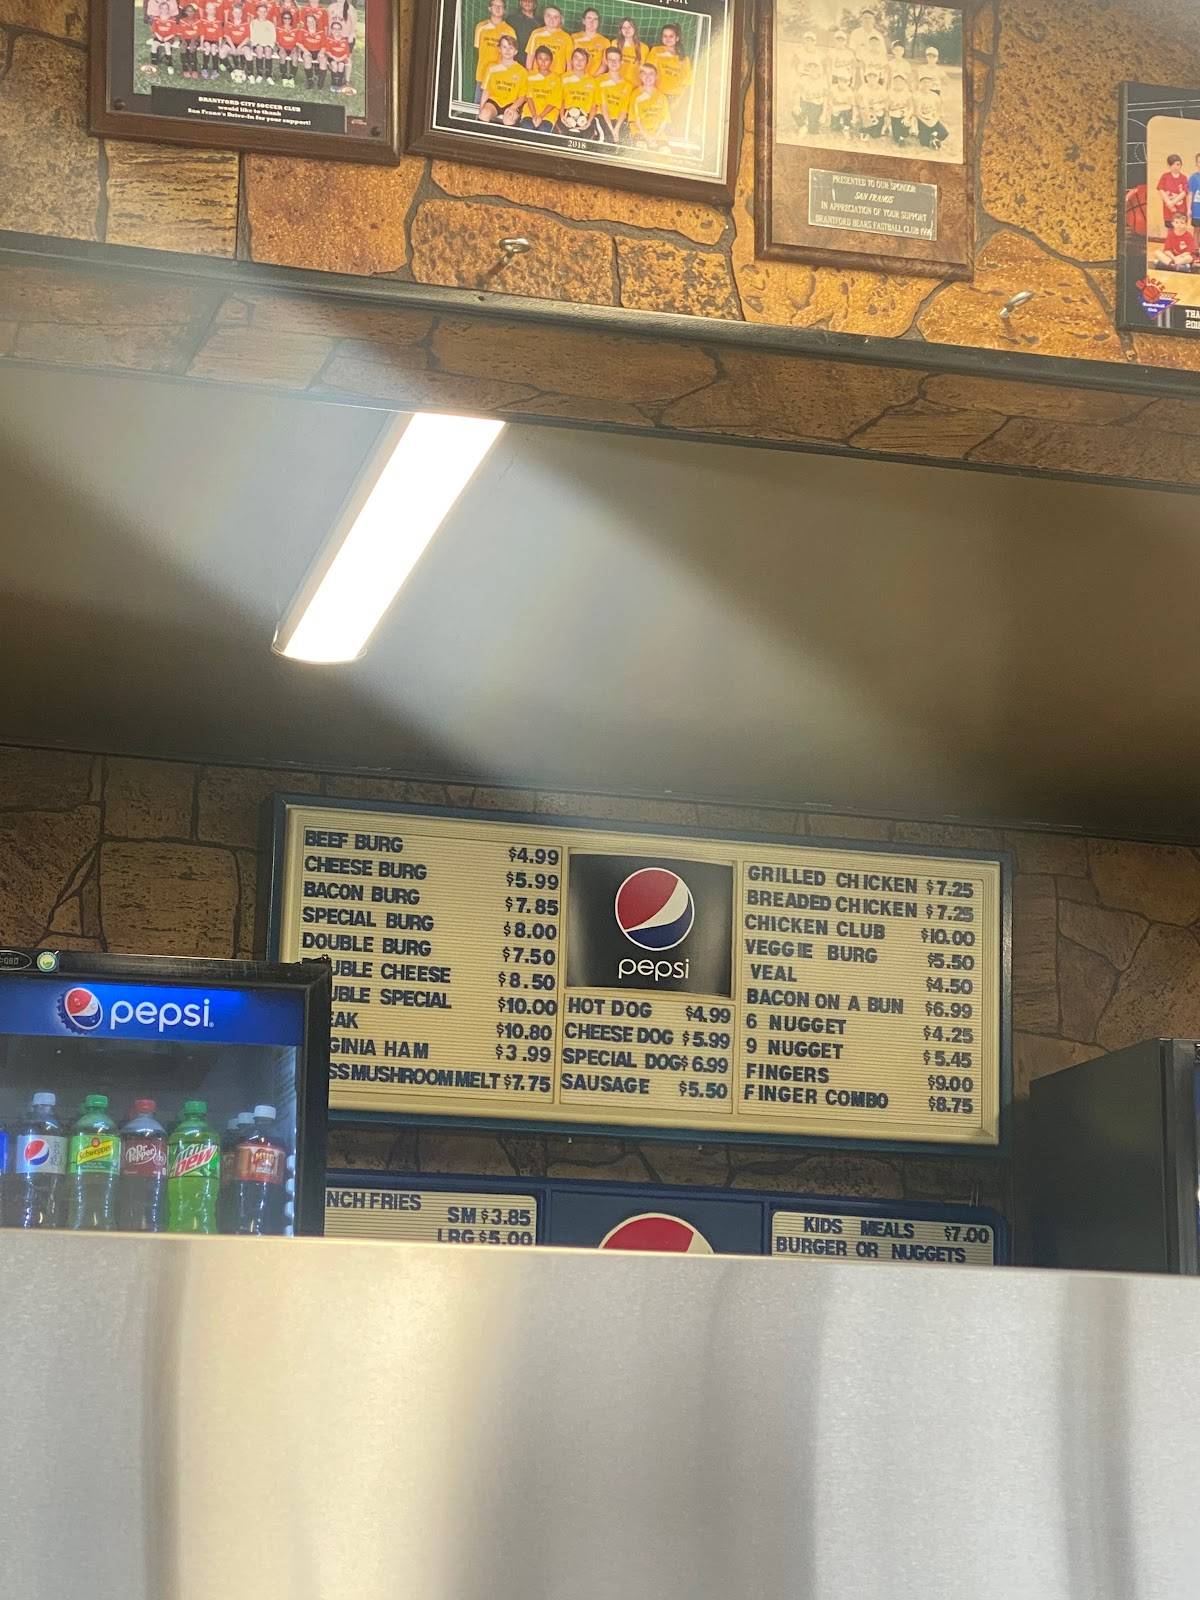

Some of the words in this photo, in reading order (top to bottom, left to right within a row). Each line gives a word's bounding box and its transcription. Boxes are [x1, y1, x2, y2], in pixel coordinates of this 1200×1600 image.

[240, 100, 256, 108] CITY
[568, 139, 586, 149] 2018
[832, 174, 867, 187] PRESENTED
[304, 829, 348, 848] BEEF
[354, 833, 404, 853] BURG
[508, 846, 559, 865] $4.99
[304, 855, 373, 876] CHEESE
[378, 861, 428, 880] BURG
[506, 871, 559, 890] $5.99
[749, 865, 826, 886] GRILLED
[835, 872, 918, 894] CHICKEN
[926, 879, 974, 898] $7.25
[303, 880, 364, 901] BACON
[371, 885, 421, 905] BURG
[505, 896, 559, 915] $7.85
[747, 889, 832, 911] BREADED
[835, 896, 918, 918] CHICKEN
[926, 903, 975, 923] $7.25
[302, 906, 377, 928] SPECIAL
[385, 912, 434, 932] BURG
[503, 921, 557, 940] $8.00
[744, 914, 829, 936] CHICKEN
[836, 921, 886, 940] CLUB
[921, 927, 976, 947] $10.00
[302, 932, 374, 953] DOUBLE
[382, 937, 432, 957] BURG
[502, 946, 556, 966] $7.50
[745, 938, 813, 959] VEGGIE
[827, 944, 878, 964] BURG
[927, 952, 975, 971] $5.50
[331, 959, 373, 978] UBLE
[380, 963, 451, 984] CHEESE
[498, 971, 556, 991] $8.50
[617, 957, 690, 982] pepsi
[751, 963, 798, 983] VEAL
[926, 976, 974, 995] $4.50
[110, 998, 211, 1033] pepsi
[331, 985, 371, 1004] UBLE
[380, 988, 452, 1009] SPECIAL
[498, 997, 558, 1016] $10.00
[568, 996, 606, 1015] HOT
[611, 1000, 653, 1018] DOG
[685, 1005, 731, 1024] $4.99
[746, 988, 810, 1009] BACON
[814, 993, 841, 1010] ON
[847, 995, 861, 1012] A
[867, 996, 904, 1014] BUN
[925, 1000, 973, 1019] $6.99
[496, 1022, 553, 1041] $10.80
[564, 1022, 634, 1043] CHEESE
[637, 1027, 674, 1045] DOG
[682, 1030, 730, 1049] $5.99
[746, 1012, 758, 1029] 6
[769, 1015, 847, 1035] NUGGET
[923, 1024, 974, 1044] $4.25
[329, 1036, 377, 1056] GINIA
[384, 1040, 429, 1060] HAM
[495, 1043, 551, 1063] $3.99
[562, 1048, 637, 1068] SPECIAL
[644, 1053, 681, 1071] DOG
[681, 1055, 729, 1074] $6.99
[746, 1037, 758, 1054] 9
[767, 1039, 844, 1060] NUGGET
[923, 1049, 972, 1069] $5.45
[329, 1063, 351, 1080] SS
[503, 1074, 551, 1093] $7.75
[561, 1073, 650, 1094] SAUSAGE
[679, 1080, 728, 1099] $5.50
[746, 1062, 830, 1084] FINGERS
[927, 1074, 974, 1092] $9.00
[744, 1084, 818, 1104] FINGER
[825, 1089, 889, 1109] COMBO
[928, 1095, 974, 1114] $8.75
[326, 1190, 365, 1209] NCH
[369, 1192, 422, 1211] FRIES
[447, 1206, 477, 1224] SM
[481, 1208, 531, 1226] $3.85
[804, 1216, 844, 1234] KIDS
[860, 1220, 915, 1239] MEALS
[944, 1225, 990, 1243] $7.00
[437, 1228, 475, 1244] LRG
[479, 1230, 533, 1246] $5.00
[776, 1236, 848, 1256] BURGER
[855, 1241, 879, 1258] OR
[891, 1244, 967, 1263] NUGGETS
